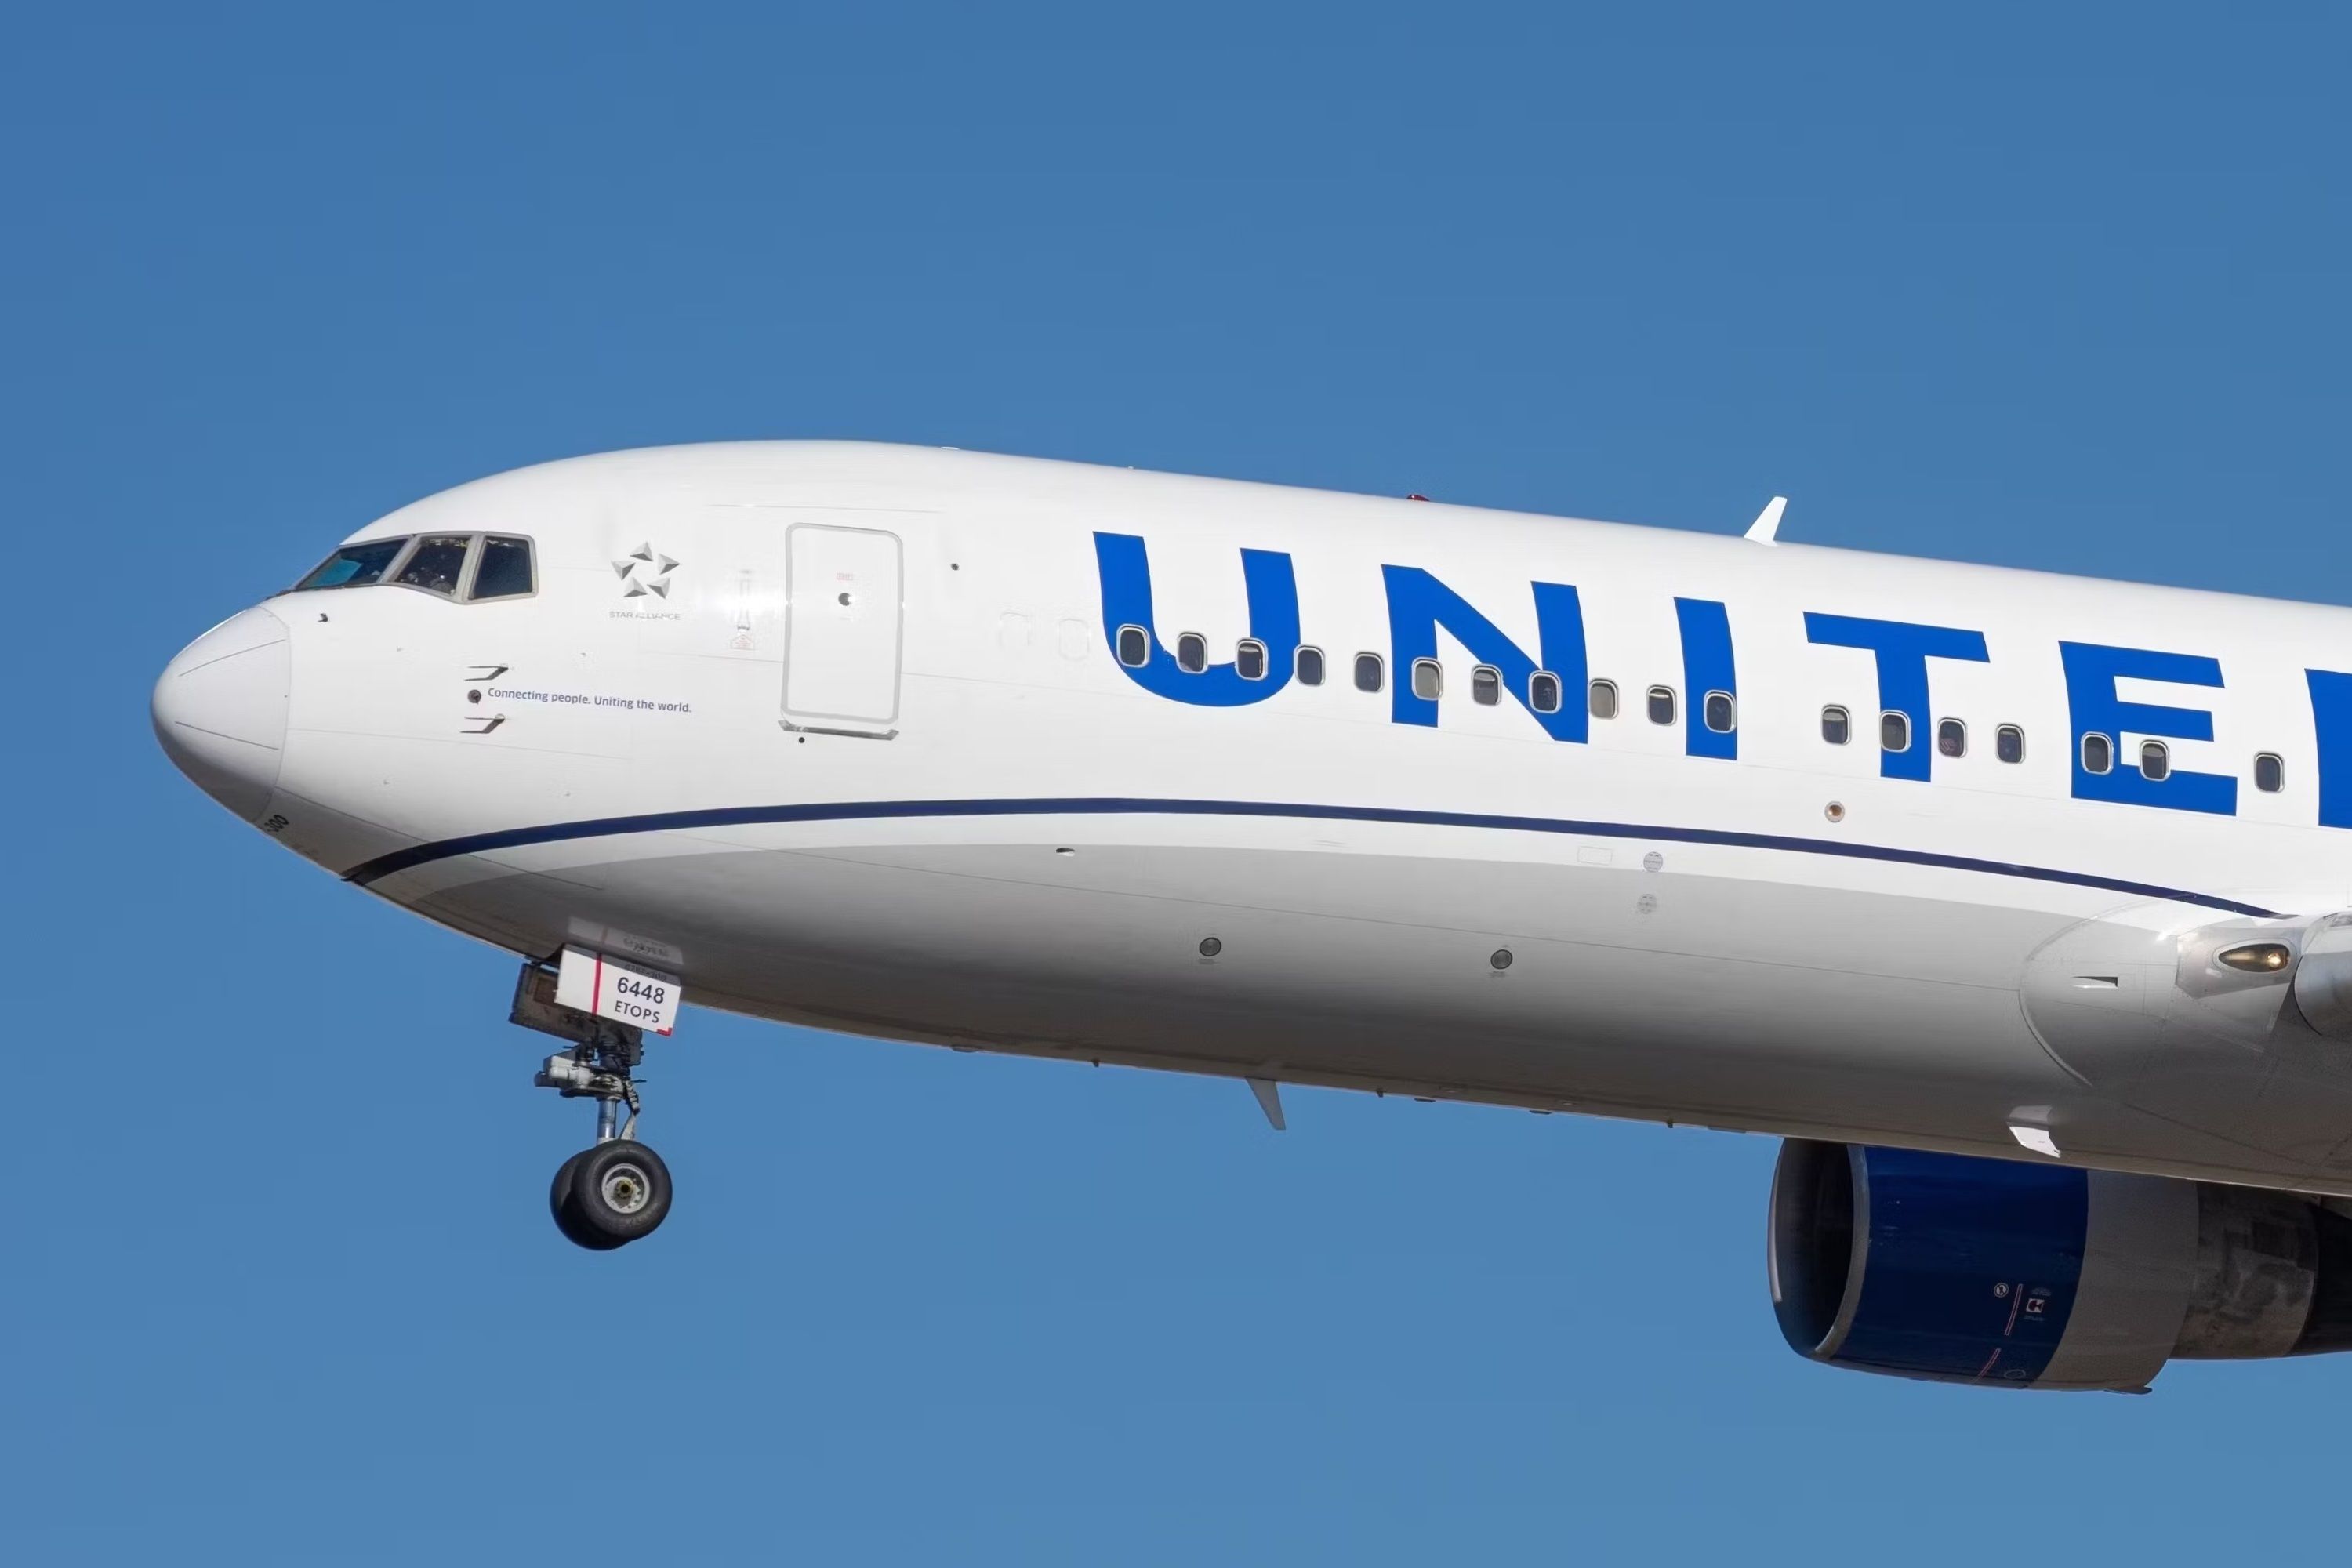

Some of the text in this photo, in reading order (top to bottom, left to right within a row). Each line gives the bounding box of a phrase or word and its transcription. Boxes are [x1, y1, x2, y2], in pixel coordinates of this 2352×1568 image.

[488, 688, 692, 713] Connecting people. Uniting the world.
[617, 977, 664, 1004] 6448
[615, 1000, 660, 1022] ETOPS
